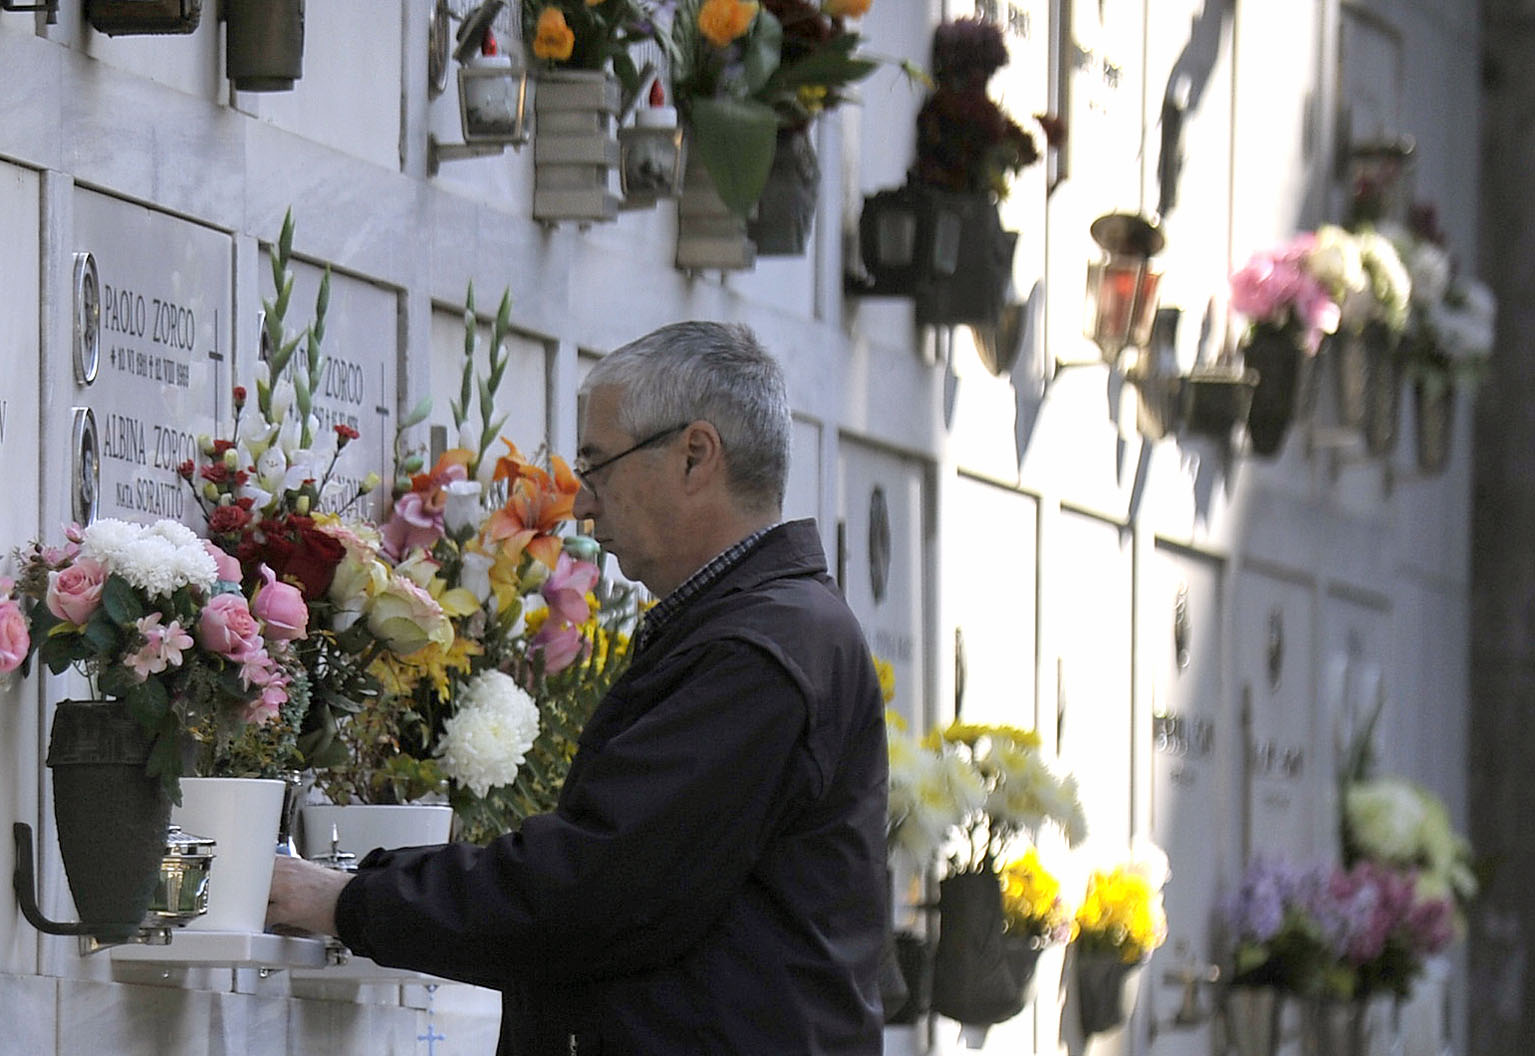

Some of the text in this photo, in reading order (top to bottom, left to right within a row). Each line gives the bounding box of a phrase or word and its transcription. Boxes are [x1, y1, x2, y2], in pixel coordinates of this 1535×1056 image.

[104, 285, 195, 352] PAOLO ZORCO
[325, 355, 364, 406] ZORCO
[104, 413, 197, 474] ALBINA ZORCO
[136, 477, 183, 520] SORAVITO
